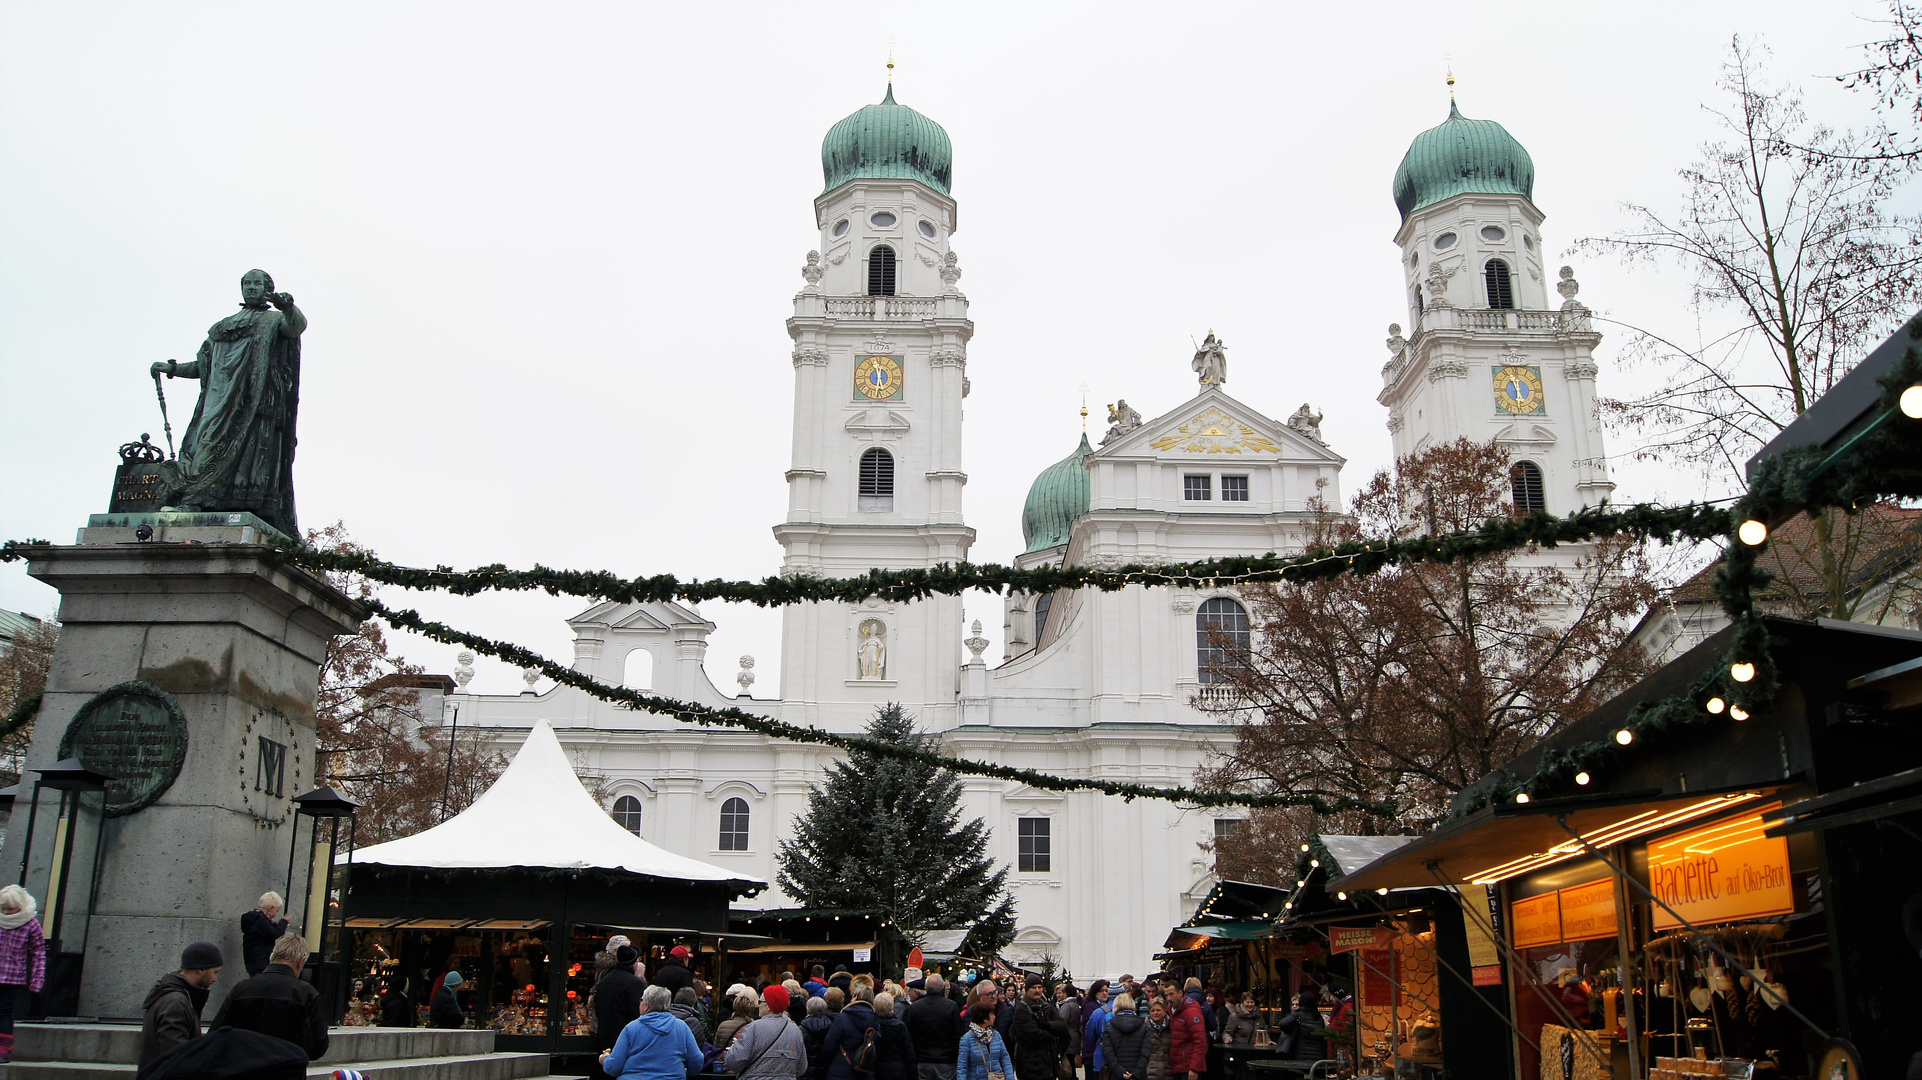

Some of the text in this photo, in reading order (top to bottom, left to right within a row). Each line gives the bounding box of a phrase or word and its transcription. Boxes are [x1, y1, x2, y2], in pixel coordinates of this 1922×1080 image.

[115, 489, 160, 501] MAGNA
[1653, 852, 1786, 908] Raclette auf Öko-Brot
[1338, 929, 1372, 939] HEISSE
[1335, 936, 1377, 947] MARONI
[1366, 952, 1397, 963] Maroi
